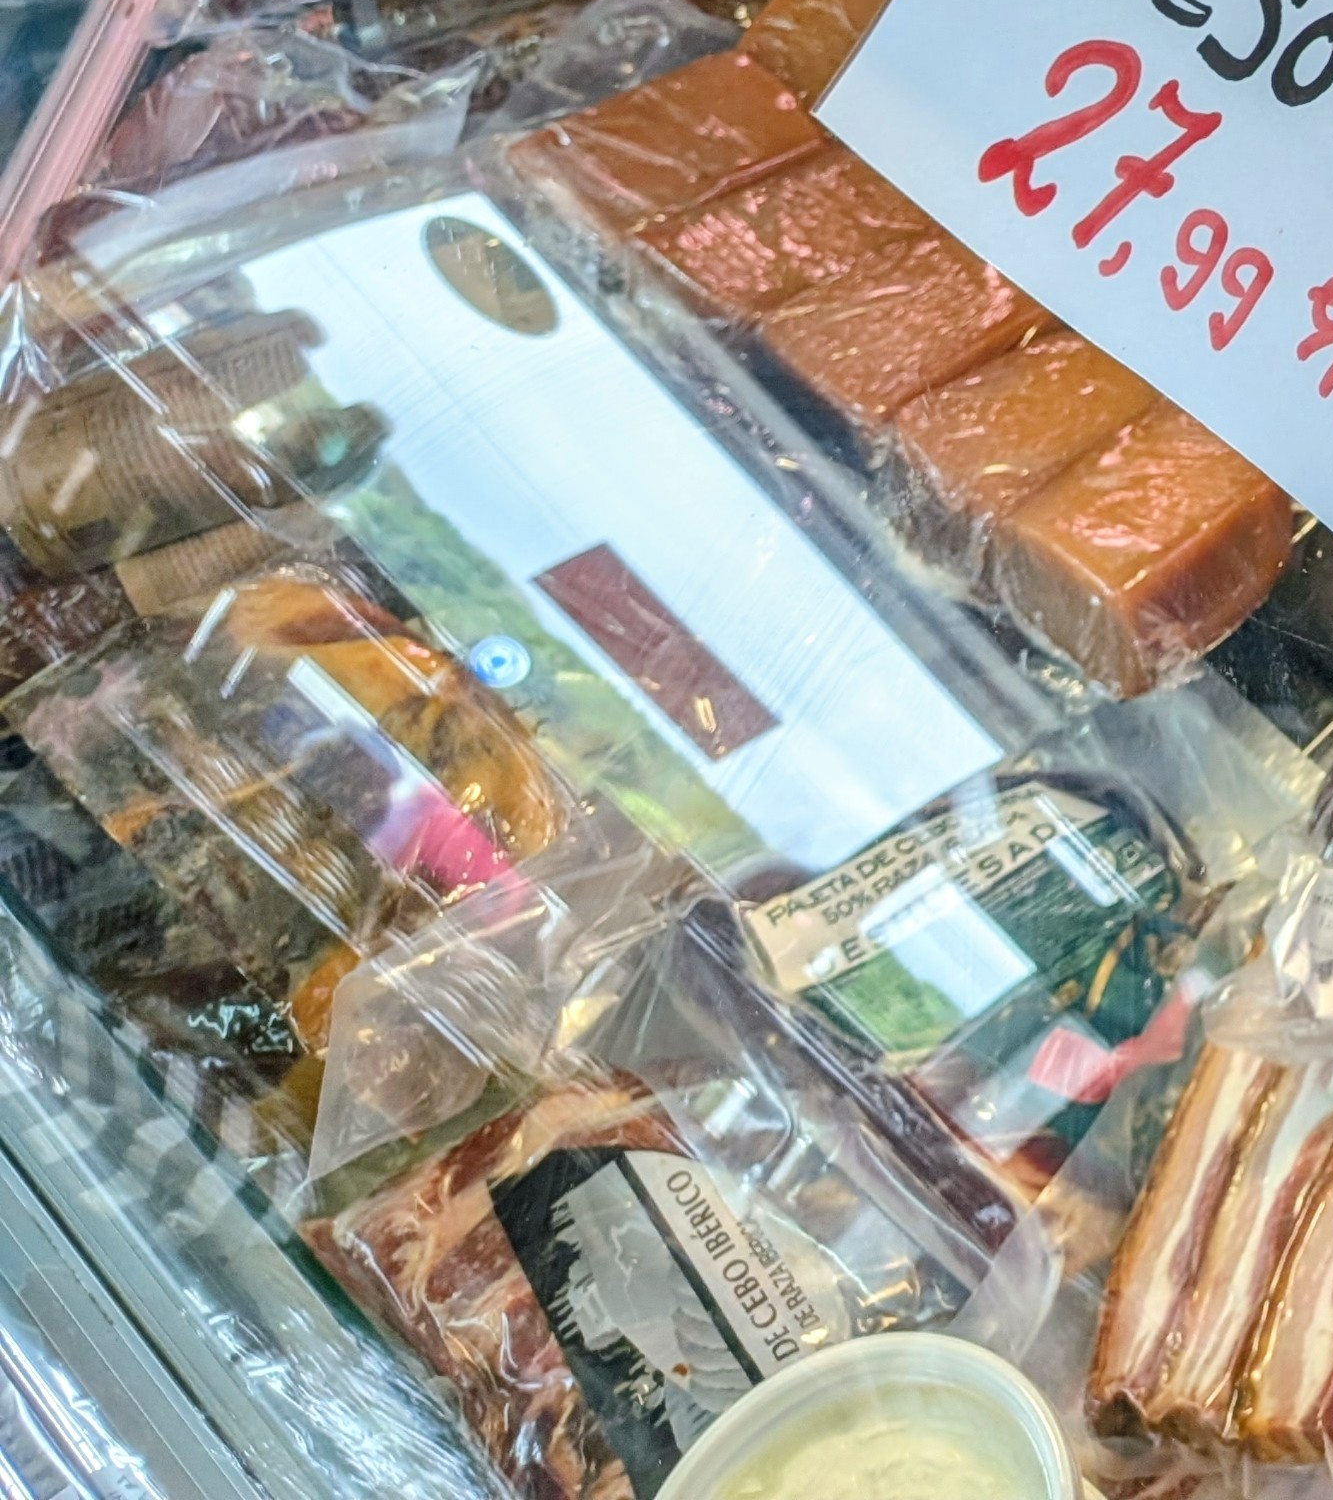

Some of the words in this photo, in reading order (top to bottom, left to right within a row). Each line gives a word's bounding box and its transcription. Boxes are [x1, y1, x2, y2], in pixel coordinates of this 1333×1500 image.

[978, 39, 1275, 351] 27,99
[766, 871, 856, 928] PALETA
[856, 849, 896, 880] DE
[666, 1169, 736, 1261] IBÉRICO
[722, 1258, 779, 1330] CEBO
[768, 1259, 808, 1312] RAZA
[794, 1303, 821, 1330] DE
[763, 1325, 800, 1363] DE
